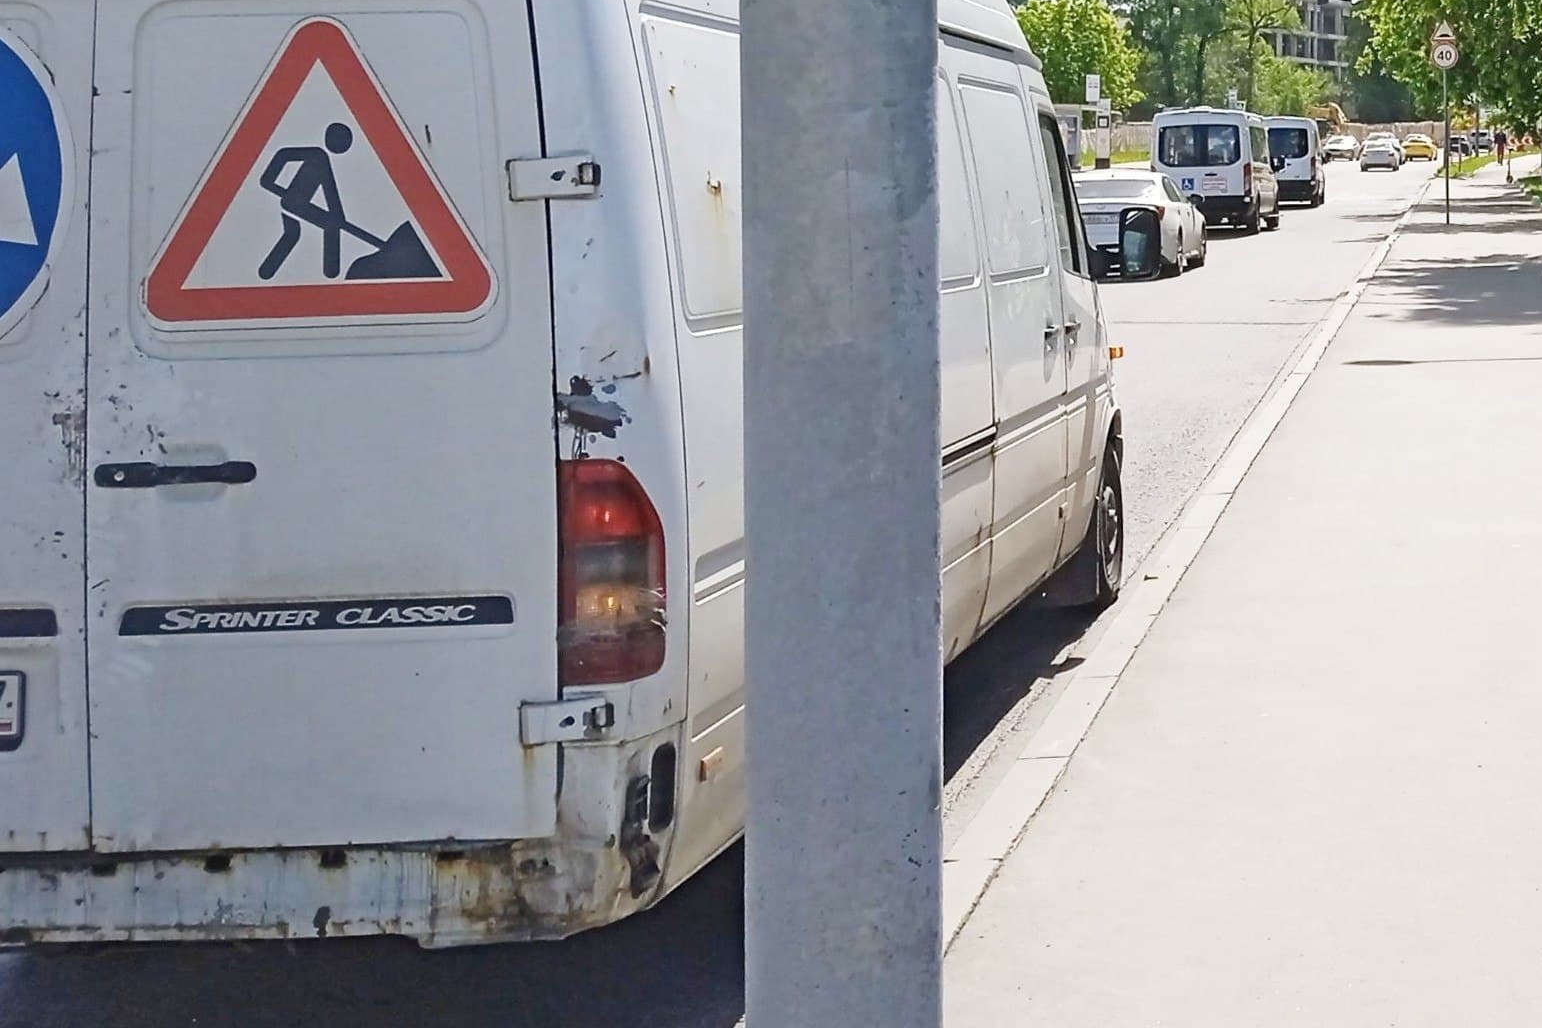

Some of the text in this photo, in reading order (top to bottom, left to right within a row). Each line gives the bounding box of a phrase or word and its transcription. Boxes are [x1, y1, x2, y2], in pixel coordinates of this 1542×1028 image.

[1437, 50, 1452, 61] 40
[159, 604, 476, 631] SPRINTER CLASSIC
